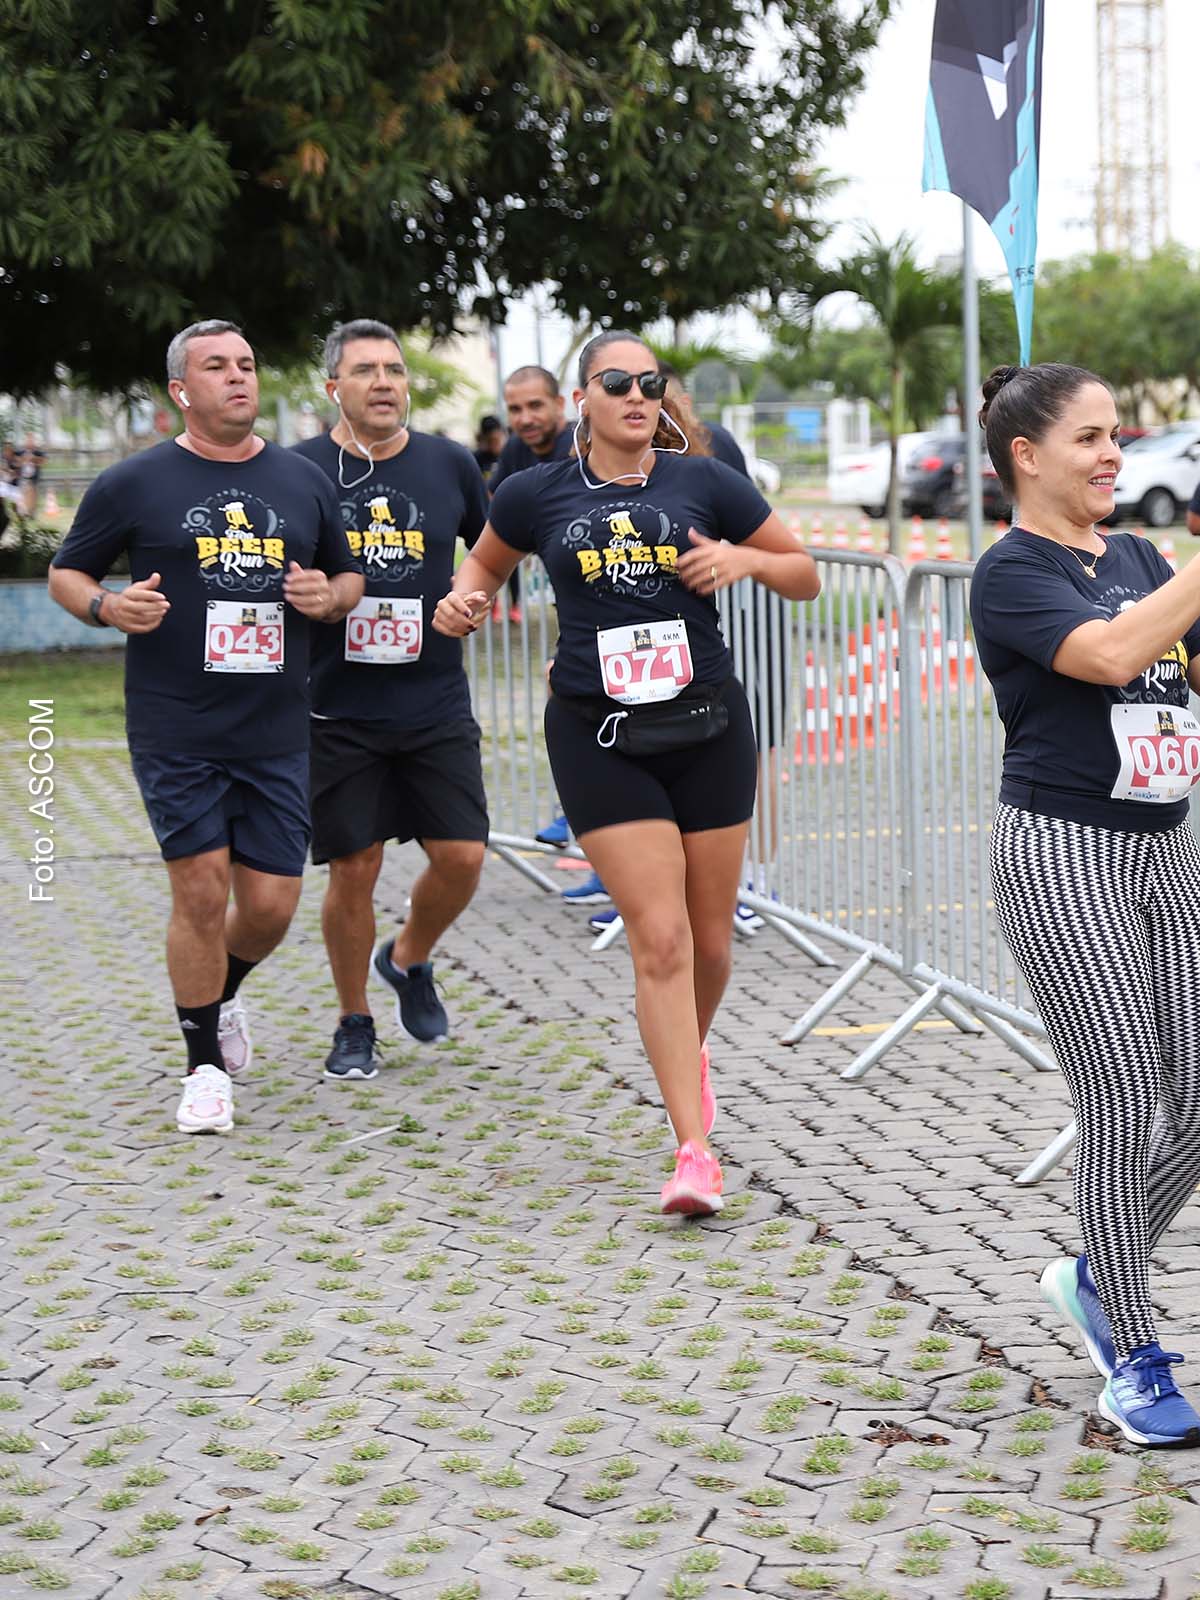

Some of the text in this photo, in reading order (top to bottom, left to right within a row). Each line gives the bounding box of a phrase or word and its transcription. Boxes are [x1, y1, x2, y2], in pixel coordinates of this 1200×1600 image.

[196, 537, 285, 560] BEER
[345, 531, 425, 554] BEER
[220, 551, 265, 577] Run
[363, 545, 406, 569] Run
[577, 545, 679, 575] BEER
[606, 561, 658, 586] Run
[210, 626, 280, 655] 043
[350, 618, 419, 648] 069
[662, 632, 680, 641] 4KM
[605, 646, 684, 687] 071
[1142, 662, 1180, 693] Run
[1183, 720, 1198, 730] 4KM
